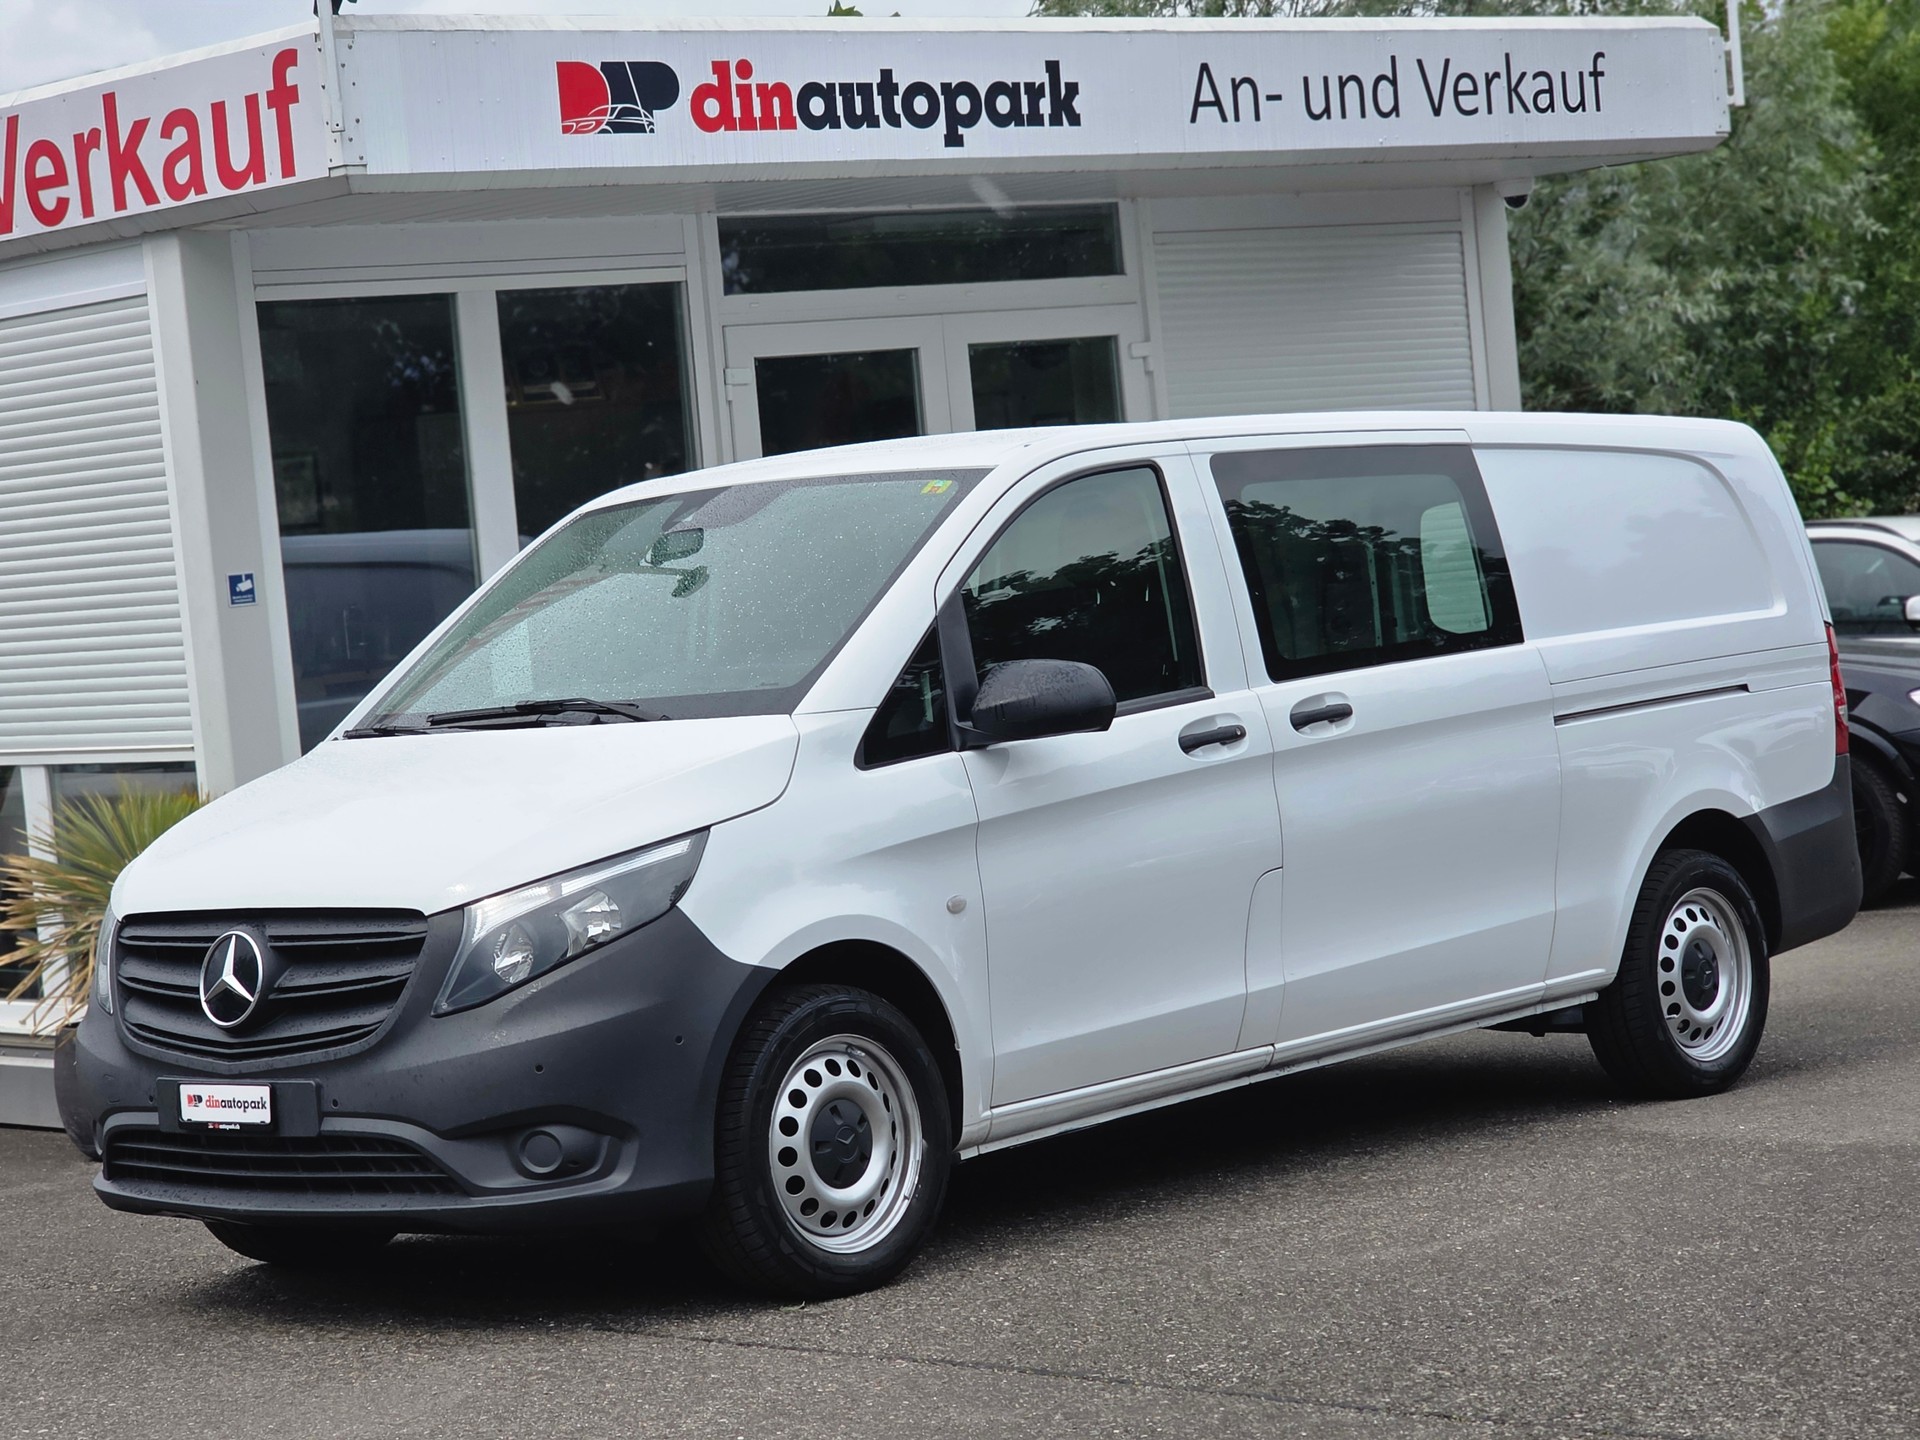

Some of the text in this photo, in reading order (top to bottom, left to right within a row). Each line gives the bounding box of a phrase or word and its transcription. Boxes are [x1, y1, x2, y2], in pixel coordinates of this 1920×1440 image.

[690, 58, 1081, 148] dinautopark
[1190, 51, 1606, 124] An- und Verkauf
[205, 1095, 267, 1113] dinautopark
